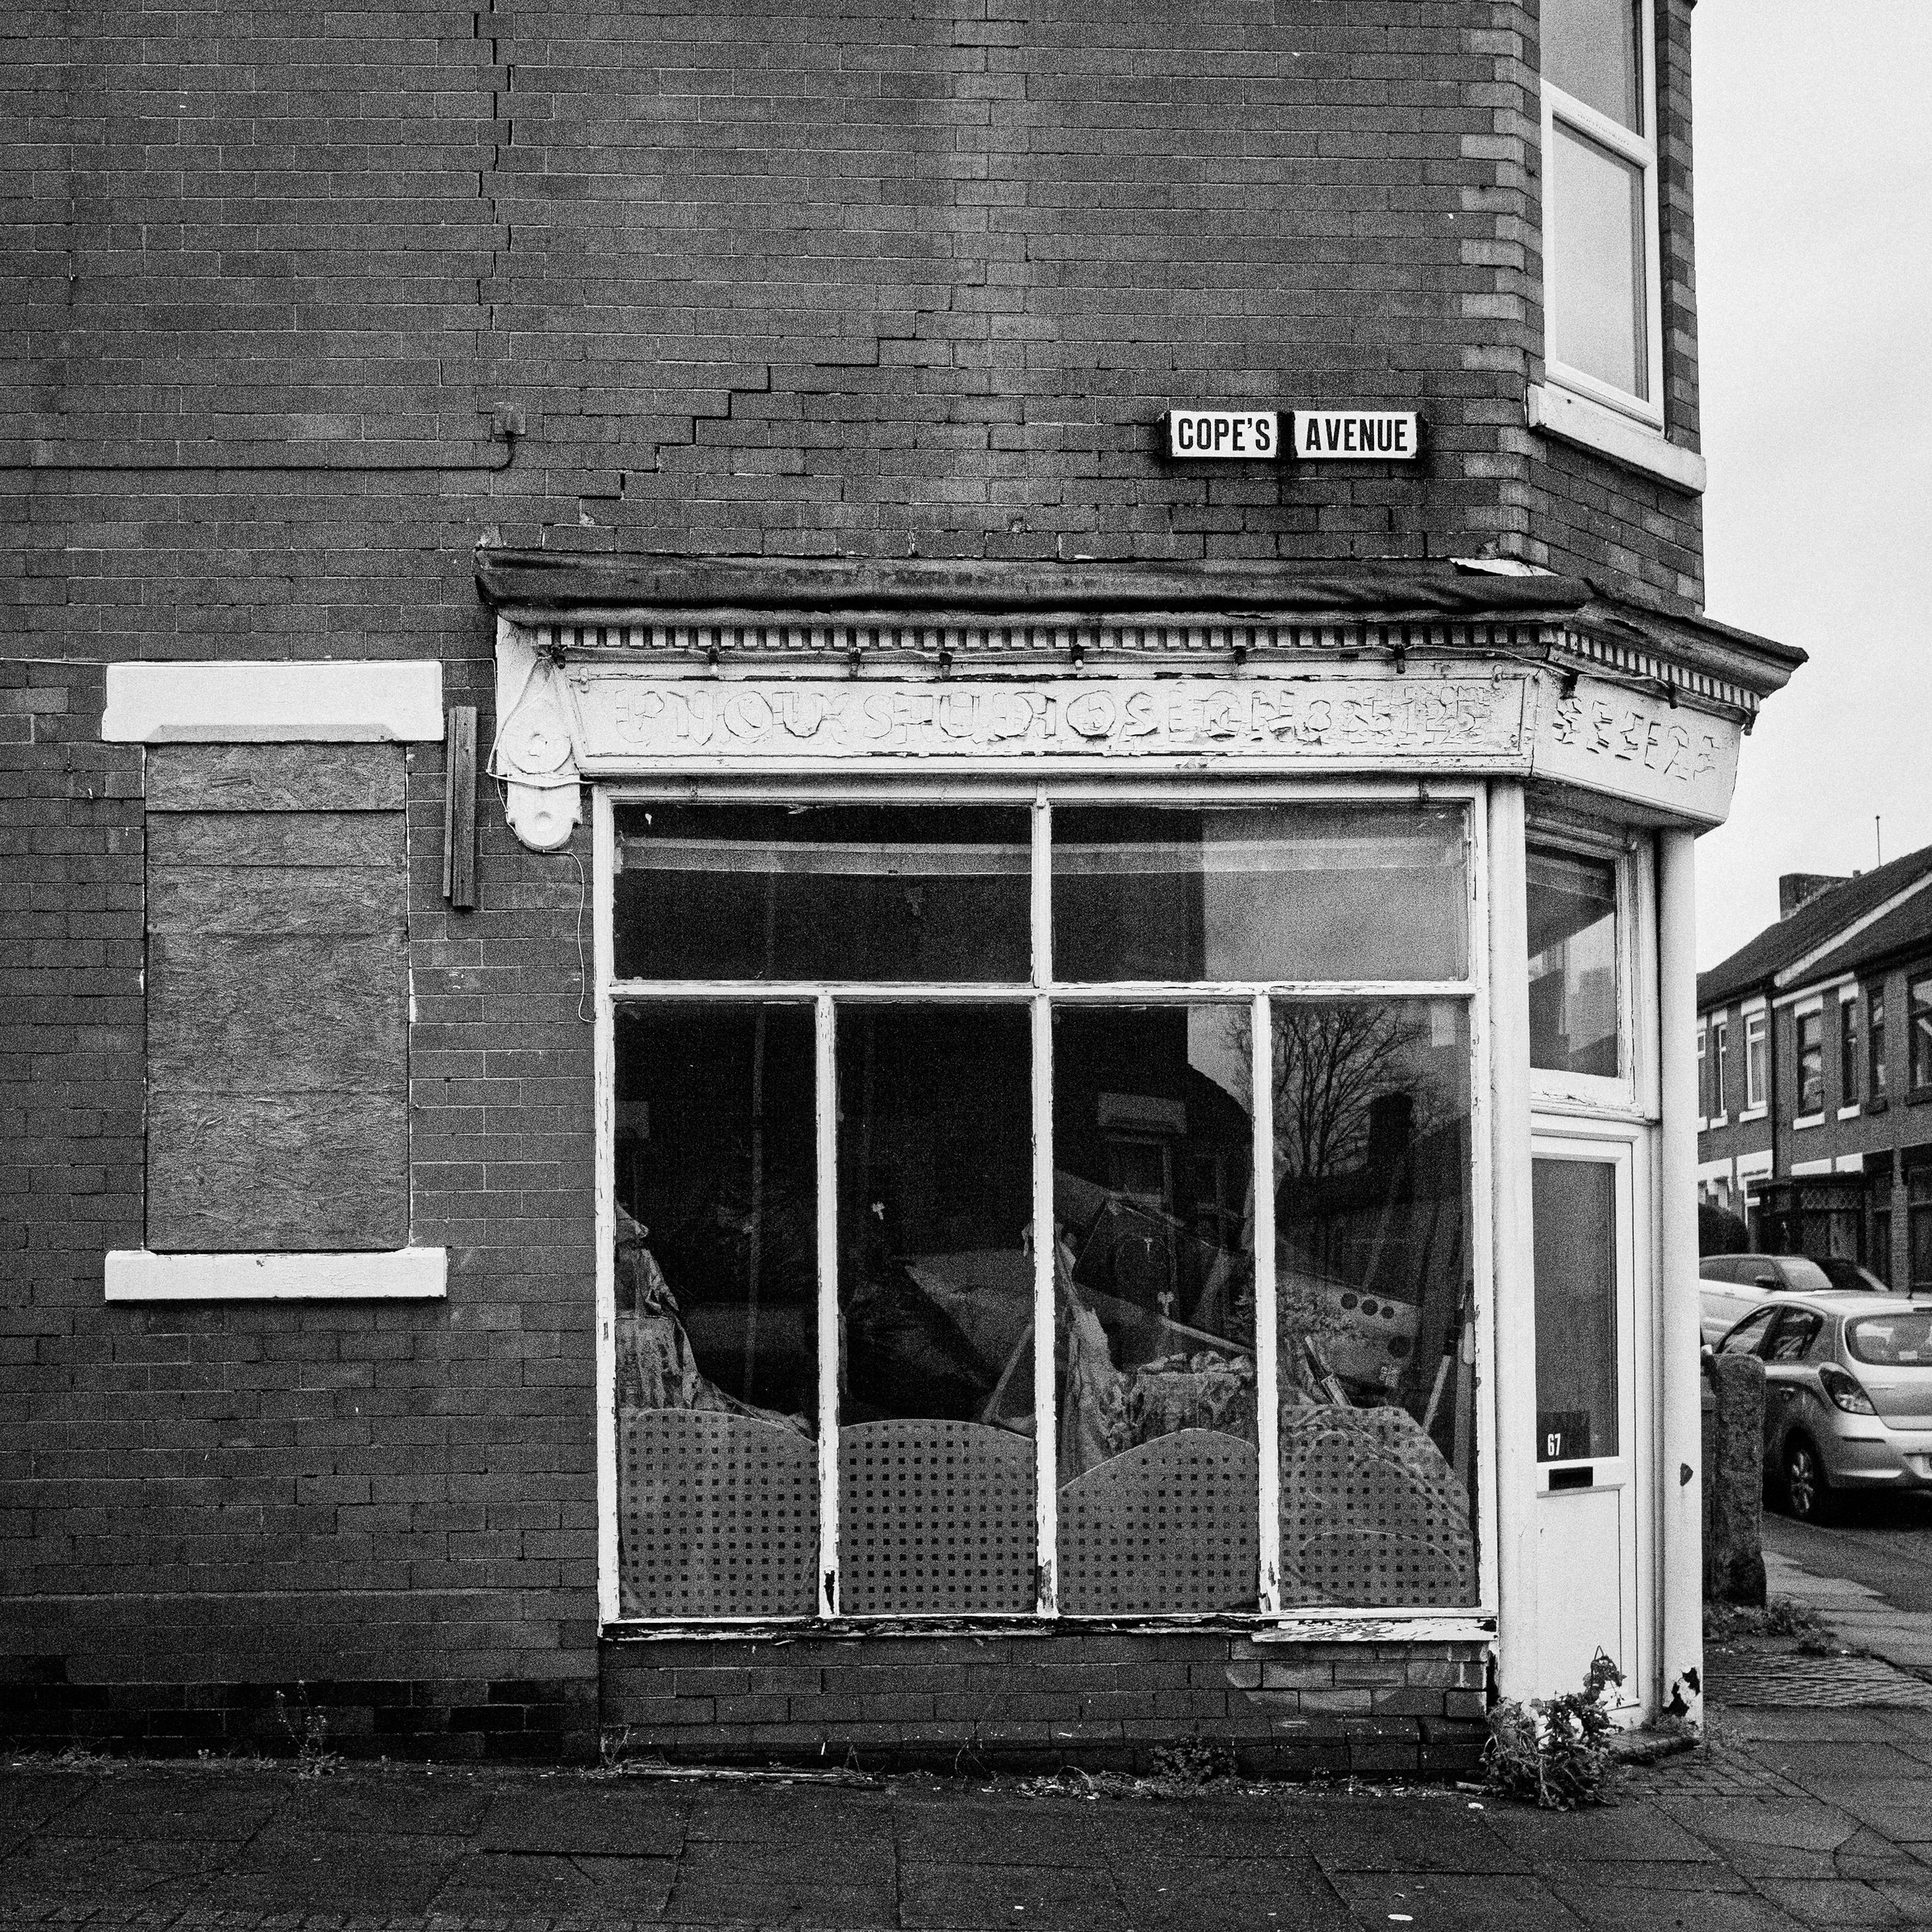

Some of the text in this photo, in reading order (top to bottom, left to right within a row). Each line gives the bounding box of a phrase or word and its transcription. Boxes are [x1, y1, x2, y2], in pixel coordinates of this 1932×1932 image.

[1178, 417, 1408, 451] COPE'S AVENUE
[1547, 1433, 1561, 1456] 67
